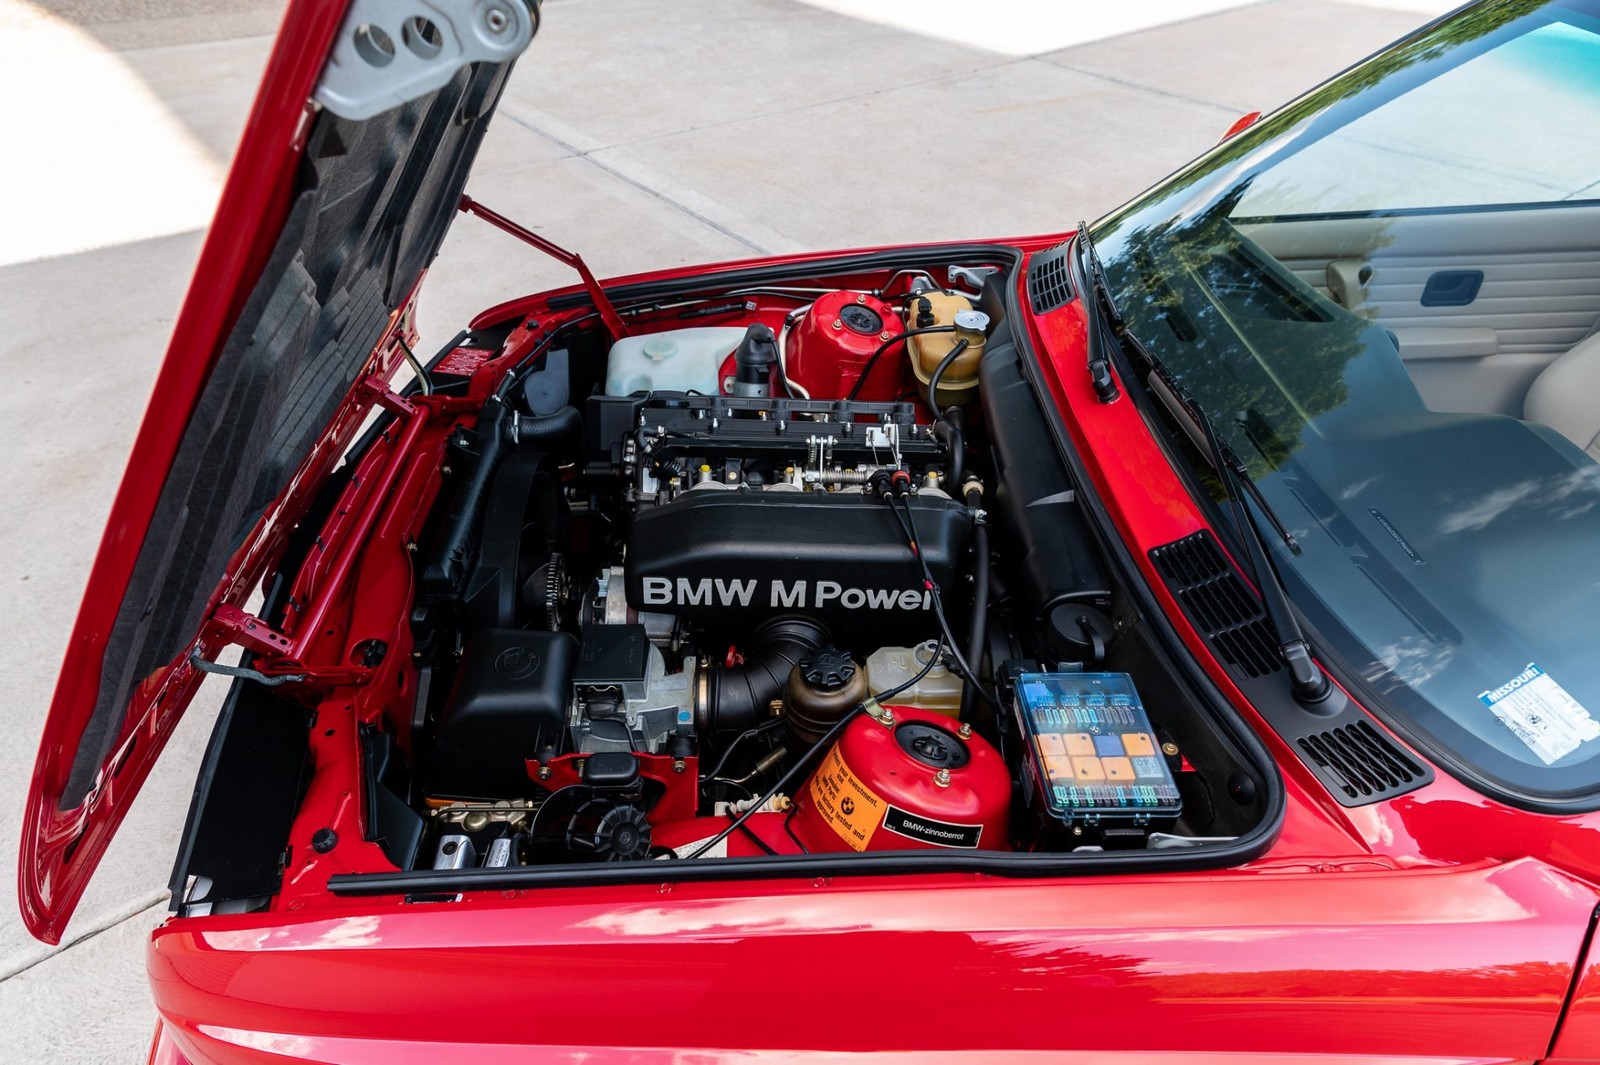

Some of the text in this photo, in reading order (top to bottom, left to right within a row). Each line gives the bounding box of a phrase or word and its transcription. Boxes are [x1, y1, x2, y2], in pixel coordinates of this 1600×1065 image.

[642, 577, 757, 606] BMW
[770, 580, 807, 608] M
[1487, 667, 1540, 702] MISSOURI
[848, 778, 877, 807] investment.
[836, 811, 852, 830] tested
[853, 829, 865, 841] and
[902, 820, 964, 840] BMW-zinnoberrot
